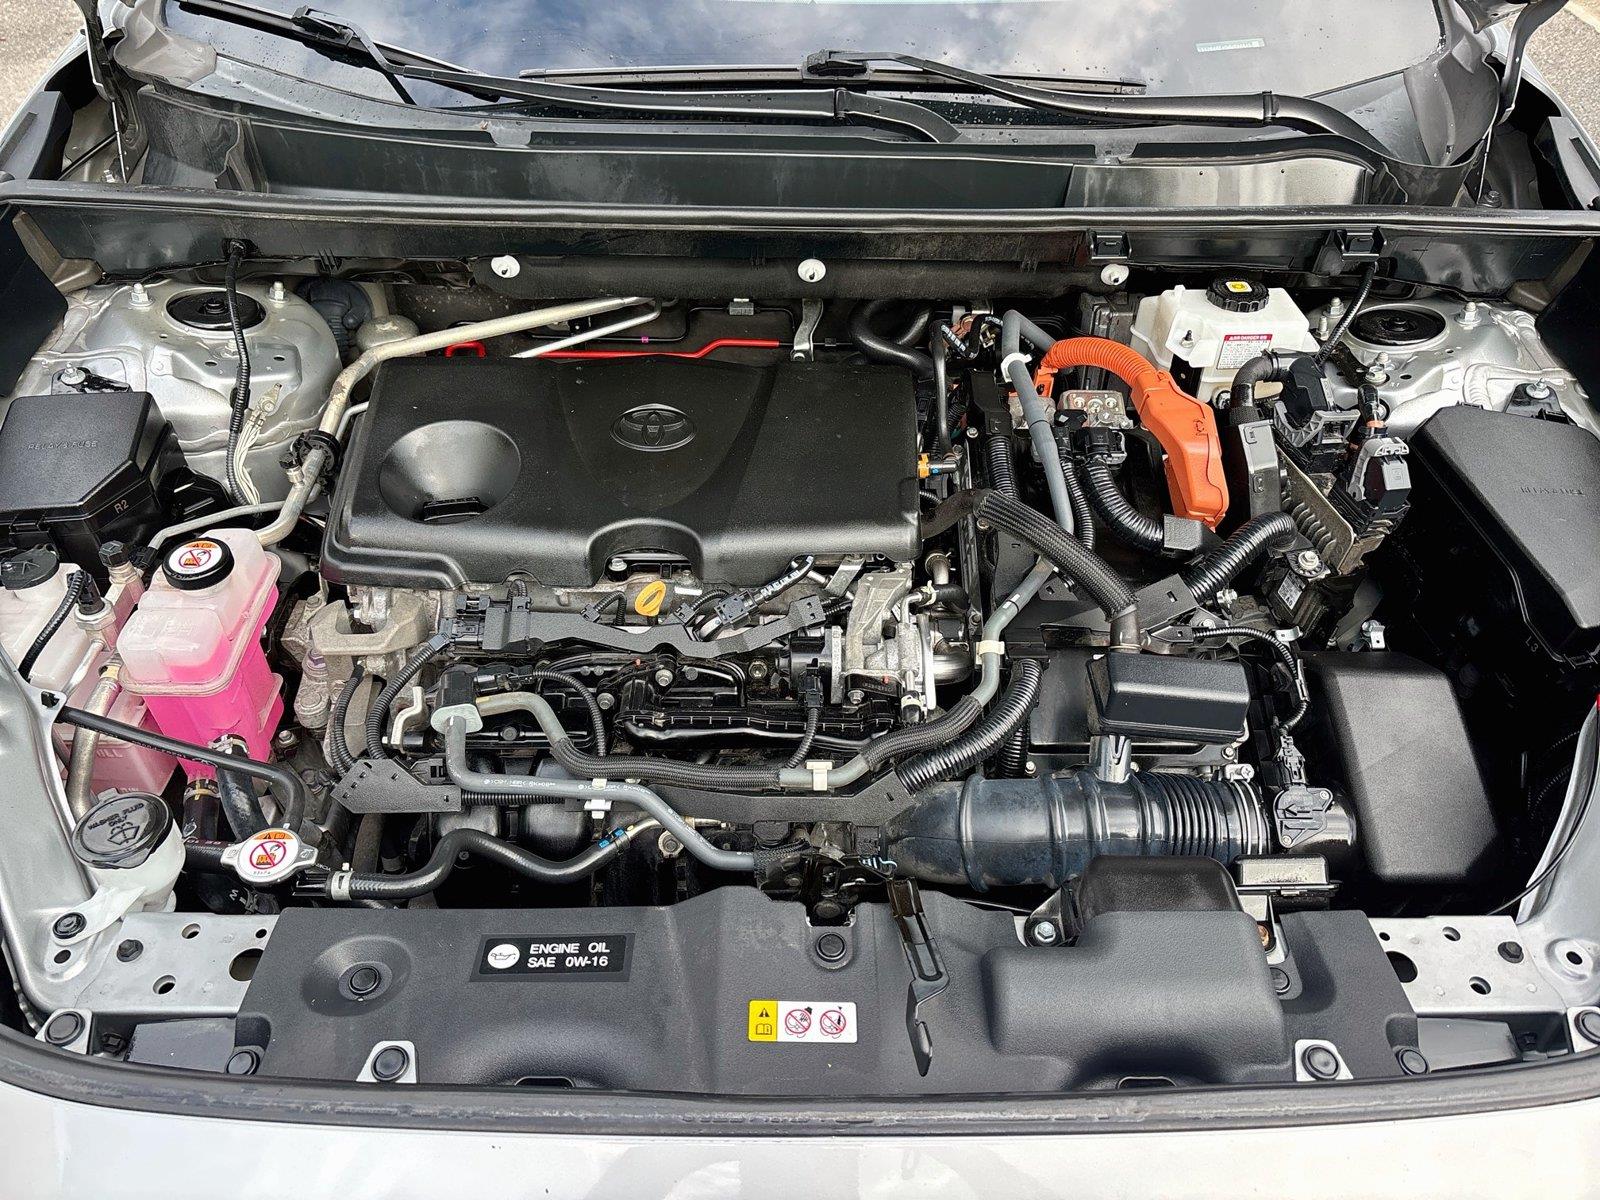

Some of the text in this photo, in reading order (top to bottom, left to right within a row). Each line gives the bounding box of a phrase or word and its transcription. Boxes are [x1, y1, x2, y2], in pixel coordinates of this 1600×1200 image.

[113, 499, 129, 514] R2
[1525, 635, 1539, 652] L3
[88, 802, 145, 830] WASHER FLUID
[108, 815, 127, 827] ONLY
[530, 942, 611, 954] ENGINE OIL
[527, 956, 608, 968] SAE 0W-16
